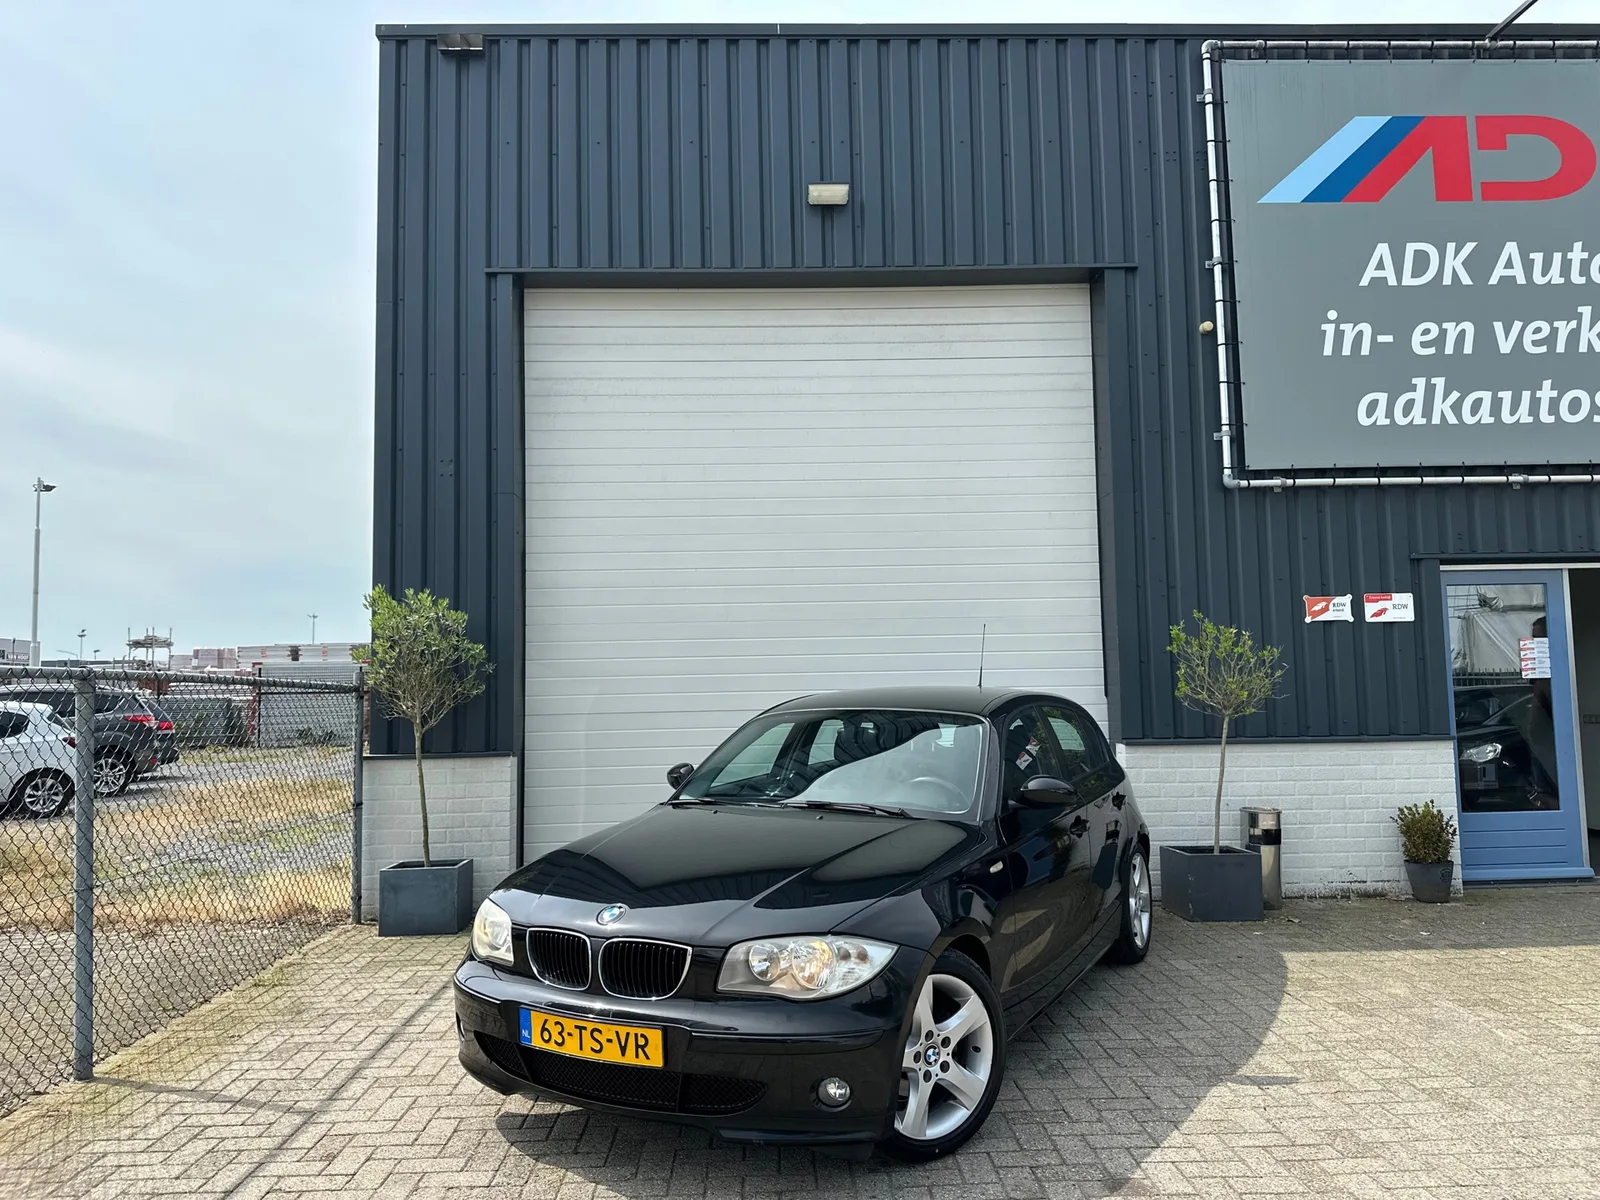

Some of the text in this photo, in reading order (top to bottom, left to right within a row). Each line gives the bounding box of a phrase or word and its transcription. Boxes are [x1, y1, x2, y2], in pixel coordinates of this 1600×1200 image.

[1358, 241, 1479, 287] ADK
[1320, 309, 1395, 356] in-
[1410, 319, 1475, 355] en
[1356, 377, 1600, 427] adkauto
[521, 1029, 531, 1039] NL
[540, 1018, 651, 1060] 63-TS-VR
